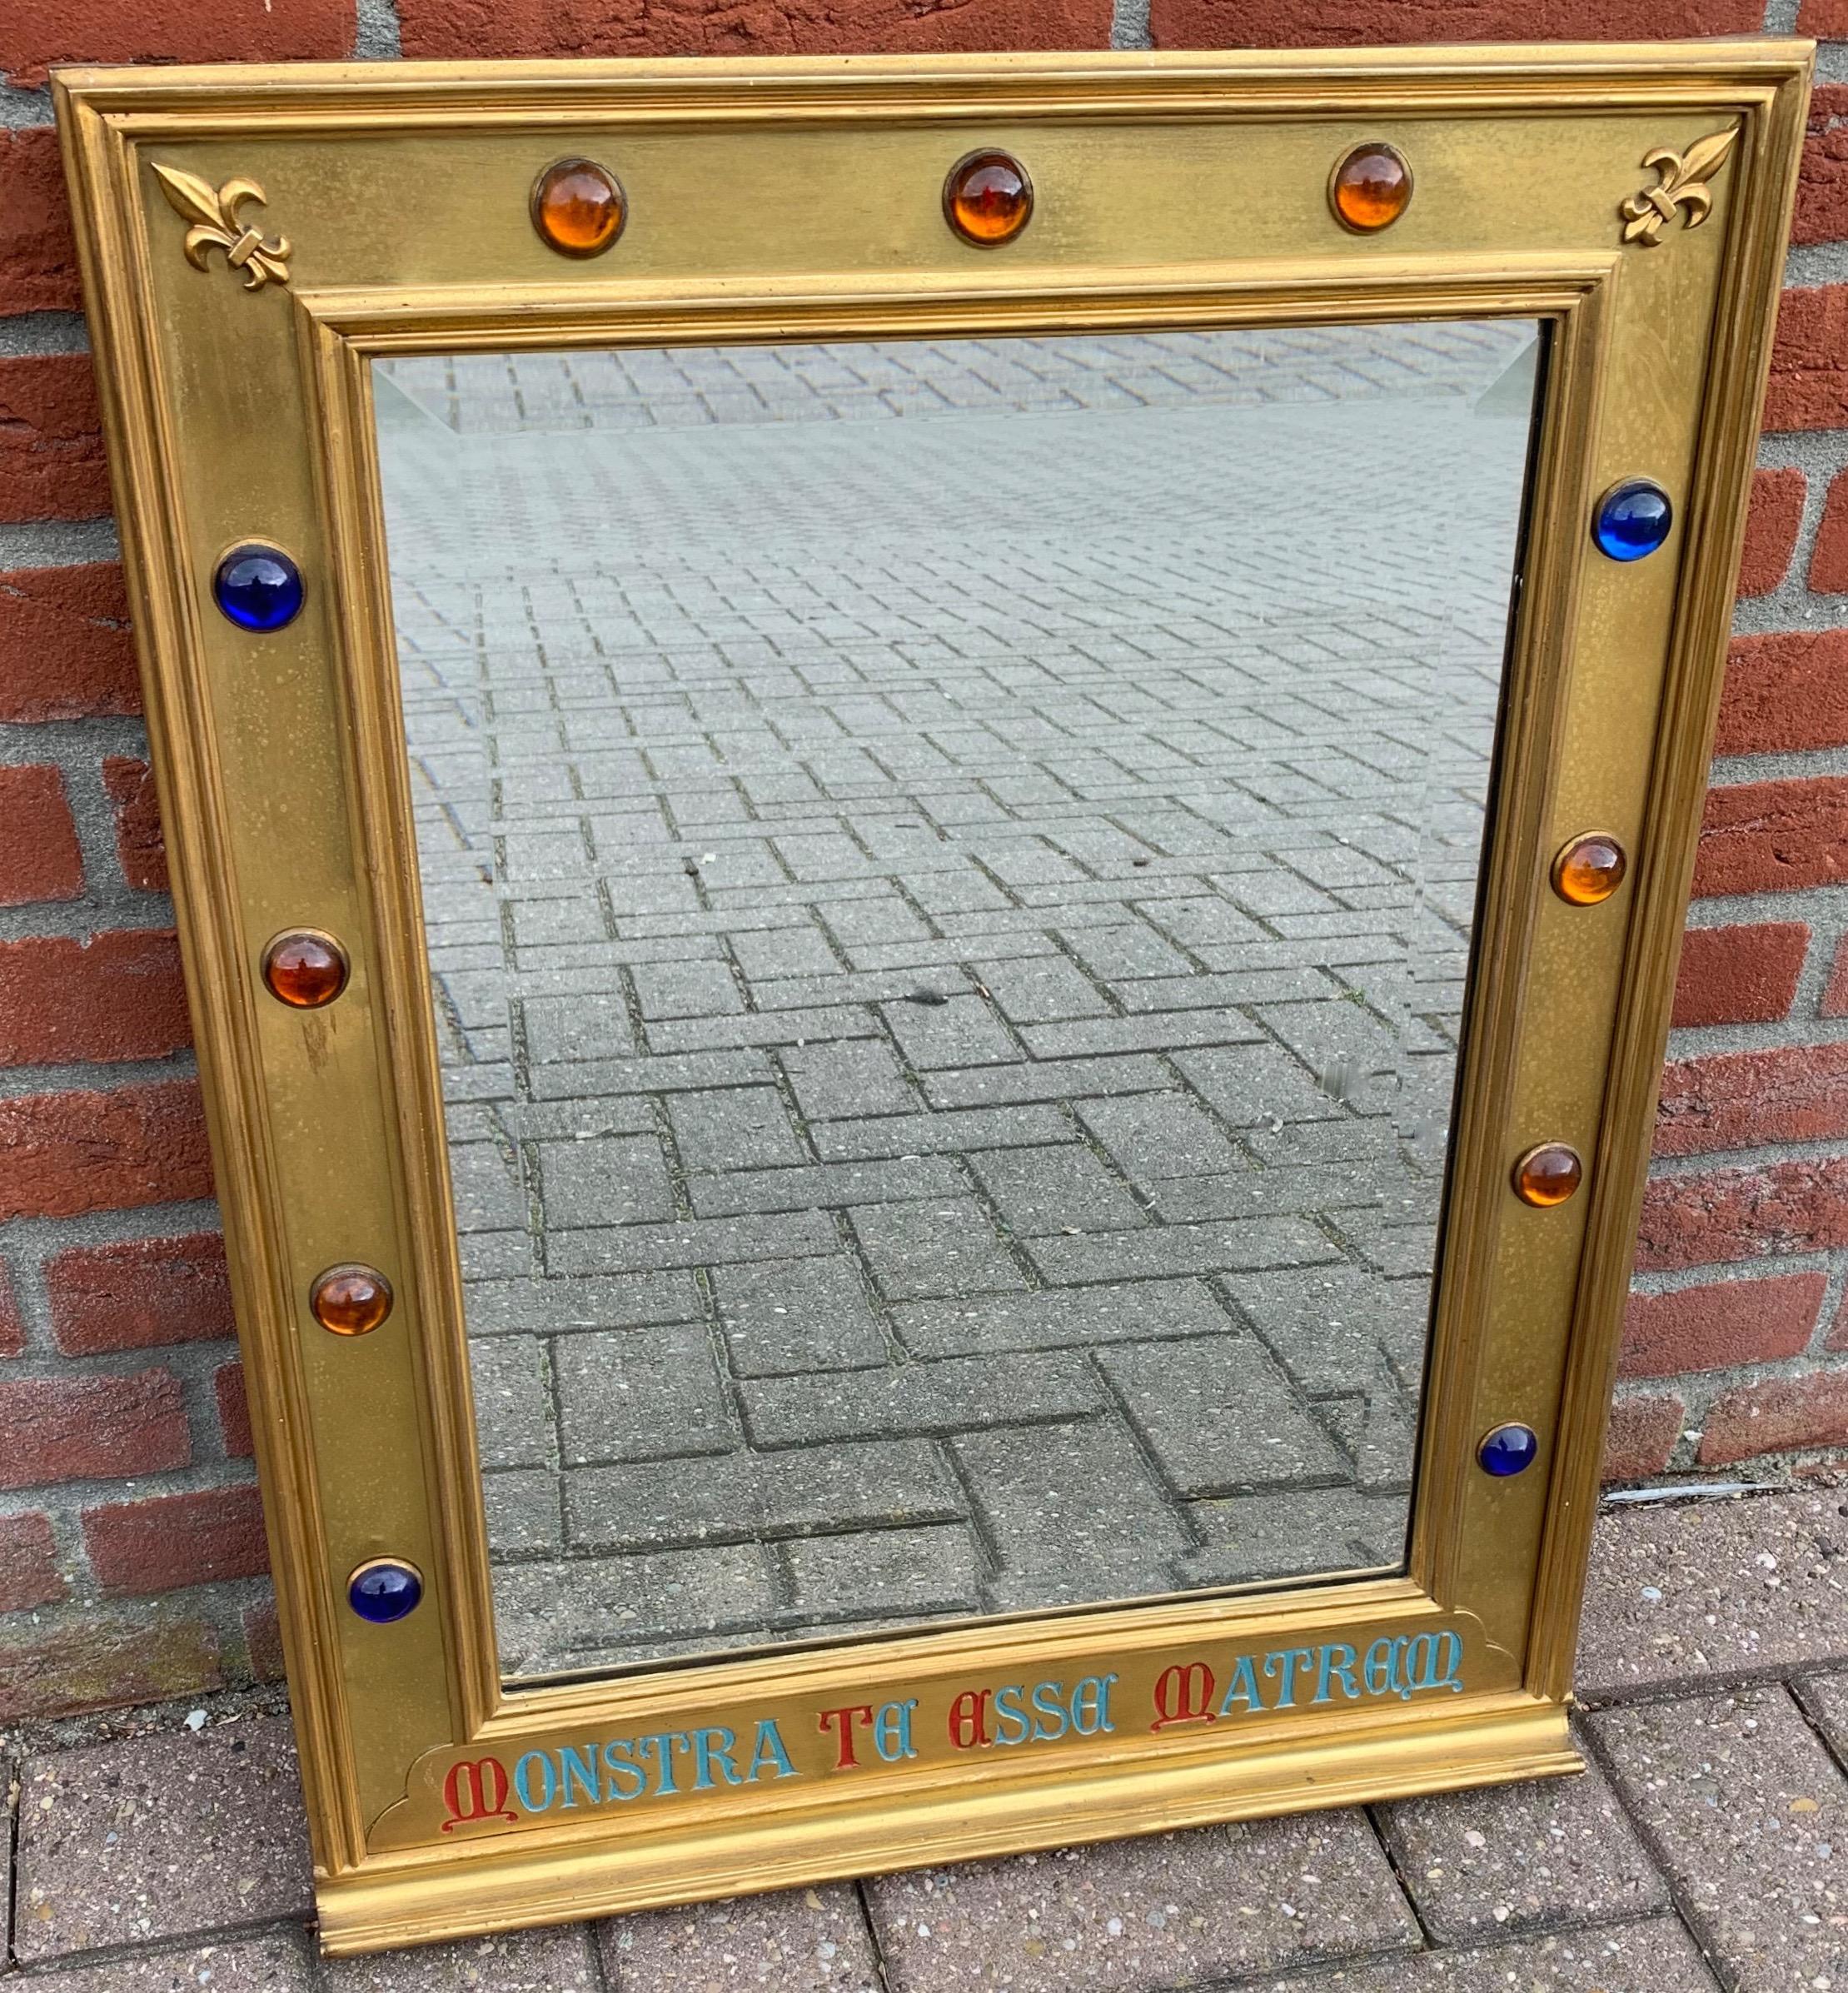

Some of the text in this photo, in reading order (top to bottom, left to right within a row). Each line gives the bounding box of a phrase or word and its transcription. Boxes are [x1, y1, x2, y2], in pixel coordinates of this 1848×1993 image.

[441, 1629, 1463, 1834] MONSTRA TE ESSE MATREM
